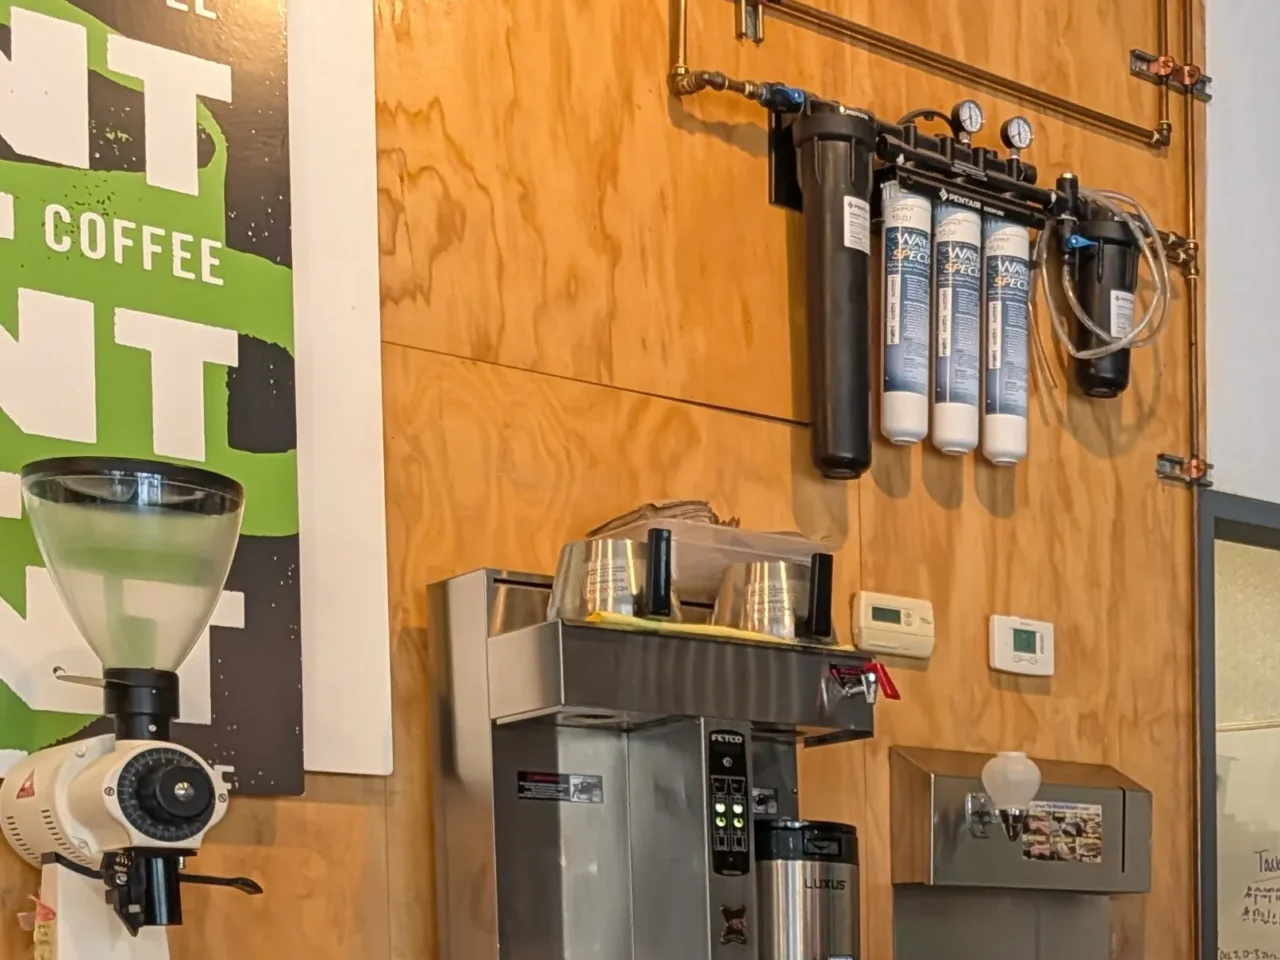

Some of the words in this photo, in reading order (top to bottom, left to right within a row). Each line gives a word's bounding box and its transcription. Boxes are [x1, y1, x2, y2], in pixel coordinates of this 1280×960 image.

[949, 194, 981, 210] PENTAIR
[45, 204, 224, 286] COFFEE
[711, 733, 743, 744] FETCO
[804, 878, 847, 891] LUXUS
